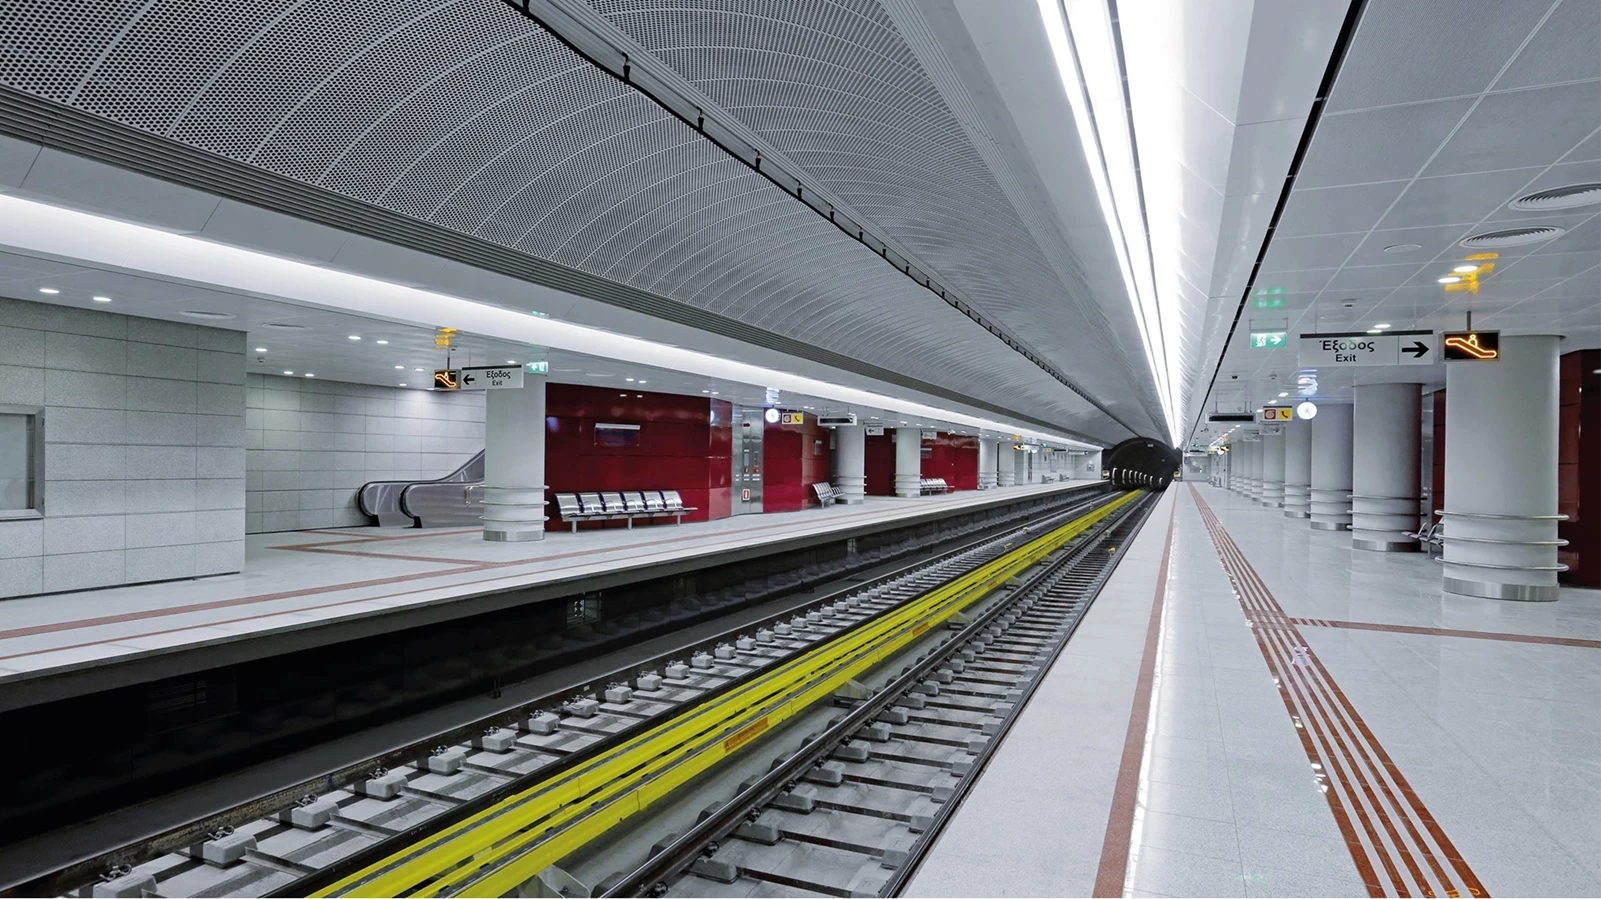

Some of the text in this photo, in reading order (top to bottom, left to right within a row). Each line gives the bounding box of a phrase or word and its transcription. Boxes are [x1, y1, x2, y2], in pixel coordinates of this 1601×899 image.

[1319, 340, 1375, 353] Έξοδος
[1336, 354, 1357, 362] Exit
[485, 370, 511, 379] Έξοδος
